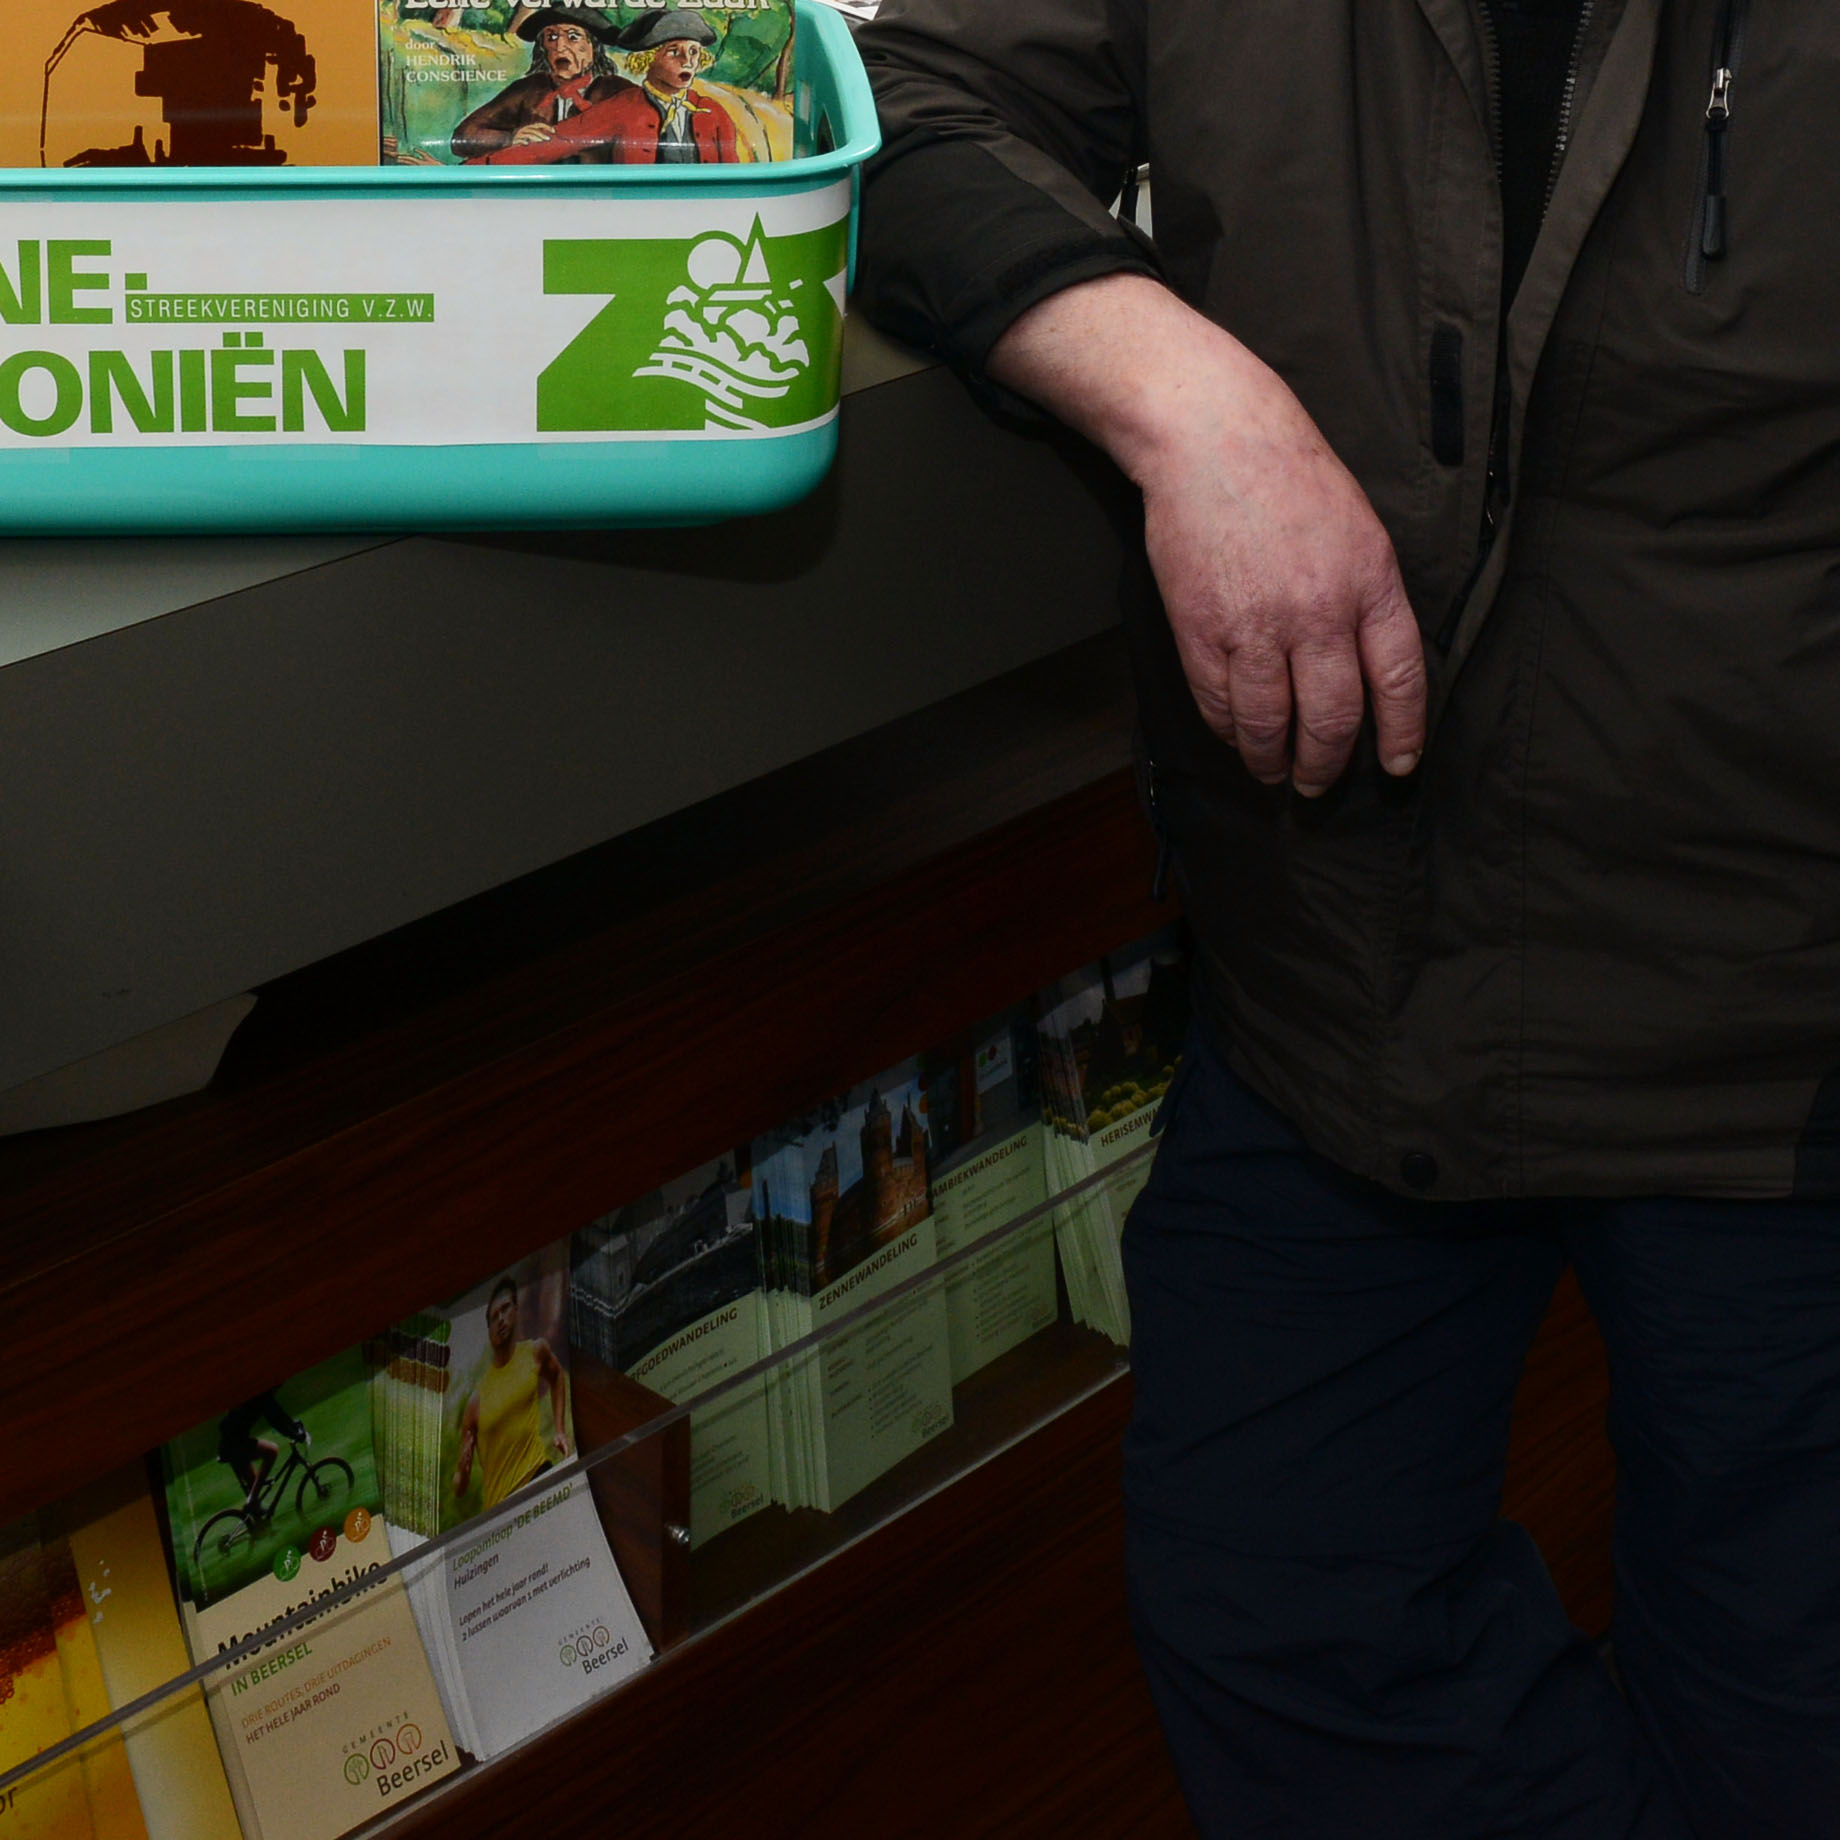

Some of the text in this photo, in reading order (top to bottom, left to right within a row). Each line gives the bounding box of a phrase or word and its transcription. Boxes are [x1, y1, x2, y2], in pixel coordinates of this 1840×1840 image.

[405, 40, 435, 51] door
[405, 53, 477, 67] HENDRIK
[405, 69, 508, 83] CONSCIENCE
[130, 299, 433, 319] STREEKVERENIGING V.Z.W.
[819, 1233, 918, 1310] ZENNEWANDELING
[453, 1524, 513, 1571] Loopomloop
[533, 1483, 574, 1519] BEEMD'
[454, 1553, 500, 1590] Huizingen
[459, 1563, 549, 1626] Lopen het hele jaar rond!
[462, 1556, 591, 1641] 2 lussen waarvan 1 met verlichting
[216, 1561, 389, 1670] Mountainbike
[230, 1641, 314, 1697] IN BEERSEL
[241, 1636, 393, 1729] DRIE ROUTES, DRIE UITDAGINGEN
[582, 1637, 629, 1675] Beersel
[246, 1683, 341, 1745] HET HELE JAAR ROND
[342, 1711, 410, 1755] GEMEENTE
[376, 1739, 450, 1797] Beersel
